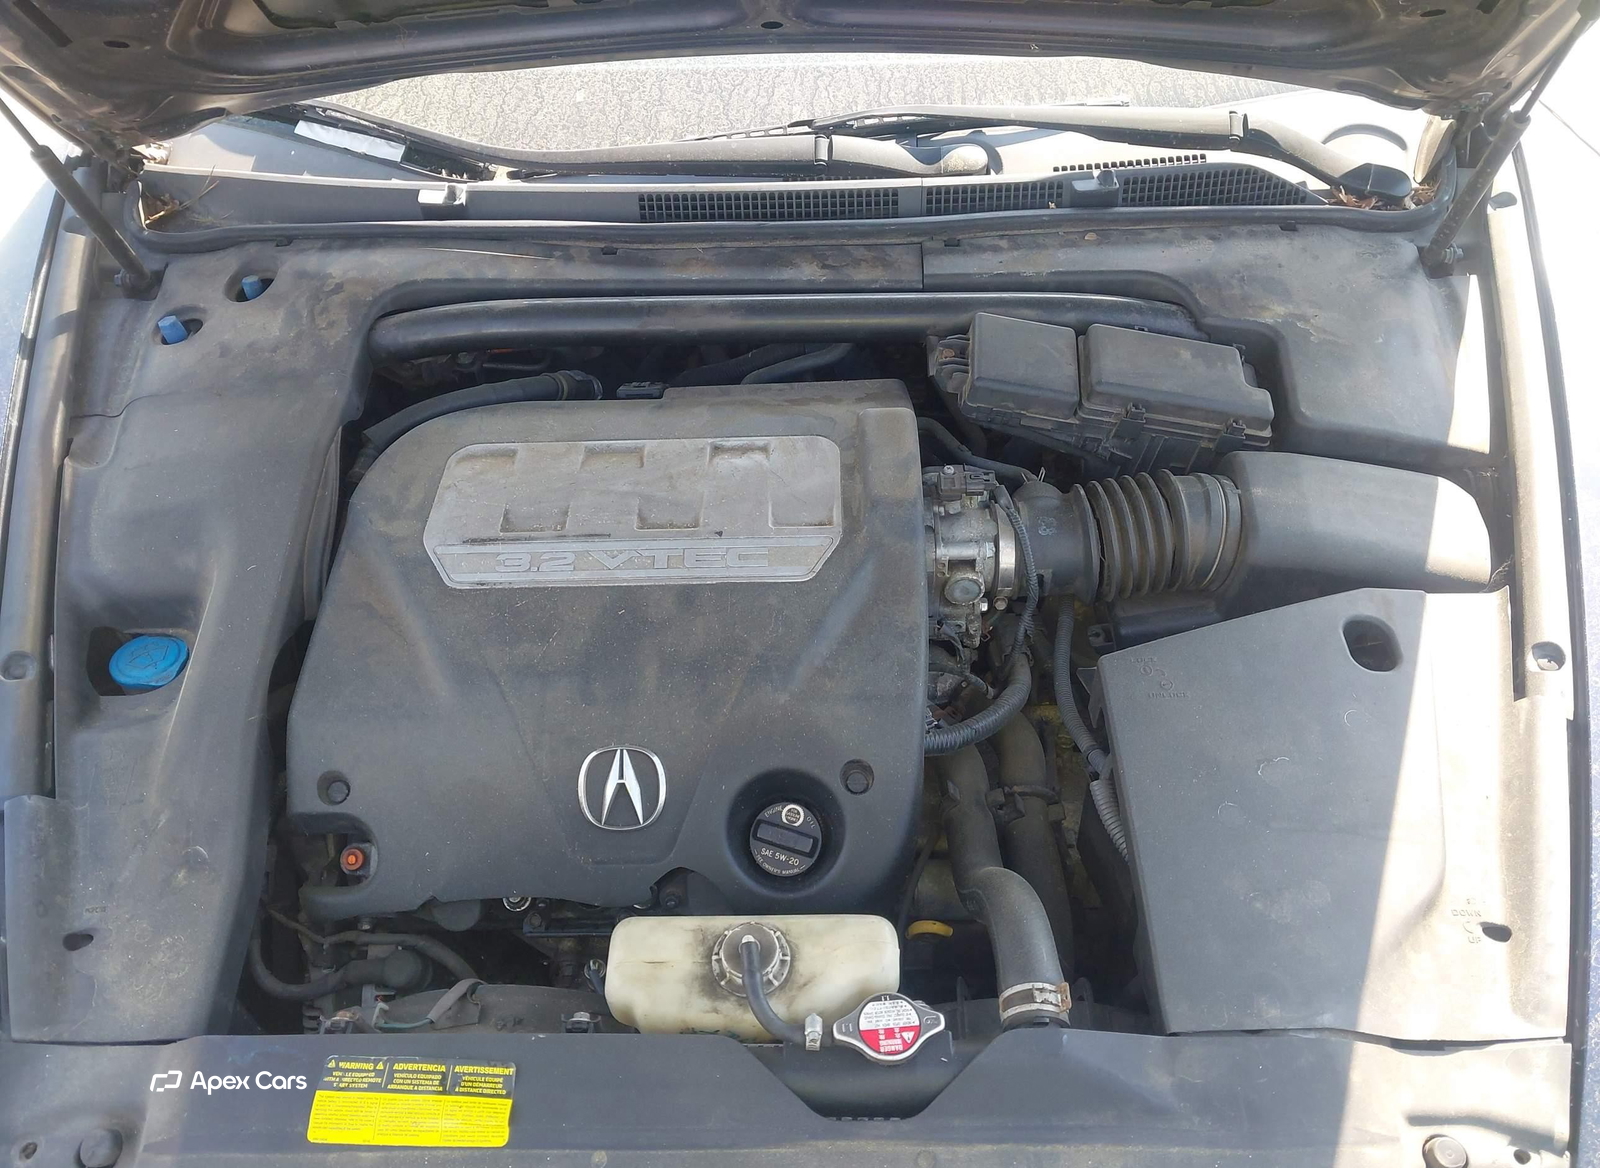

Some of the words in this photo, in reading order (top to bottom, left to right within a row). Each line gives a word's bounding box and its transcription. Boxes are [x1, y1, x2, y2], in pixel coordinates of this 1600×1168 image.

[495, 550, 576, 572] 3.2
[587, 547, 769, 570] VTEC
[1148, 690, 1191, 699] UNLOCK
[764, 805, 783, 818] ENGINE
[806, 816, 816, 829] OIL
[760, 848, 774, 858] SAE
[774, 852, 800, 866] 5W-20
[1451, 909, 1482, 917] DOWN
[1467, 936, 1482, 944] UP
[841, 1023, 853, 1032] 1.1
[880, 1045, 903, 1053] DANGER
[338, 1062, 375, 1070] WARNING
[393, 1063, 446, 1073] ADVERTENCIA
[454, 1065, 514, 1076] AVERTISSEMENT
